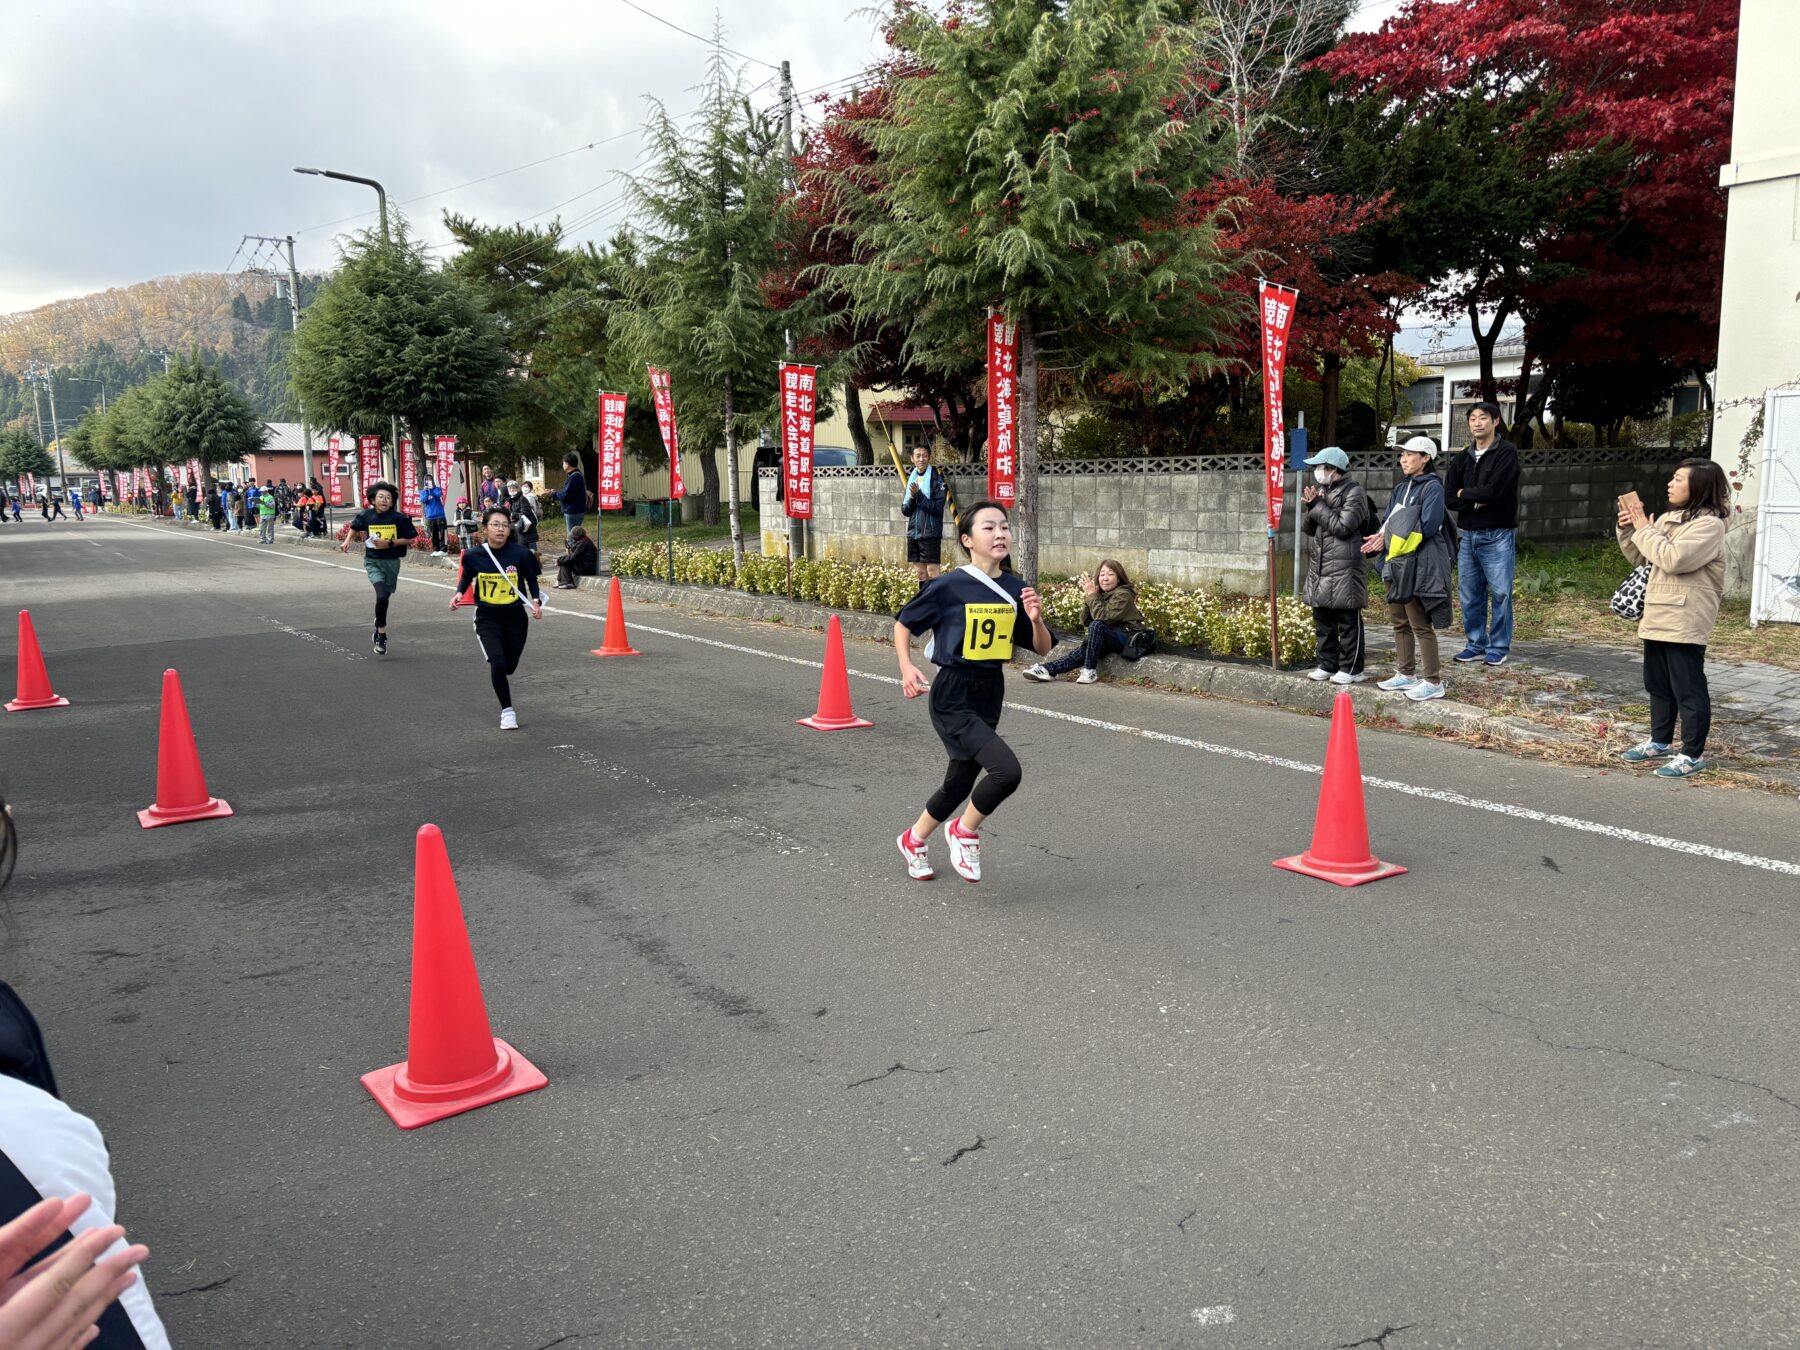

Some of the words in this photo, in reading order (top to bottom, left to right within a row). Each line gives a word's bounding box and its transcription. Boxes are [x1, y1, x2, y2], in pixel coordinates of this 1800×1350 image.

[601, 399, 615, 491] 競走大会実施中
[785, 372, 799, 492] 競走大会実施中
[798, 374, 814, 493] 南北海道駅伝
[482, 580, 516, 598] 17-4
[970, 618, 1013, 650] 19-
